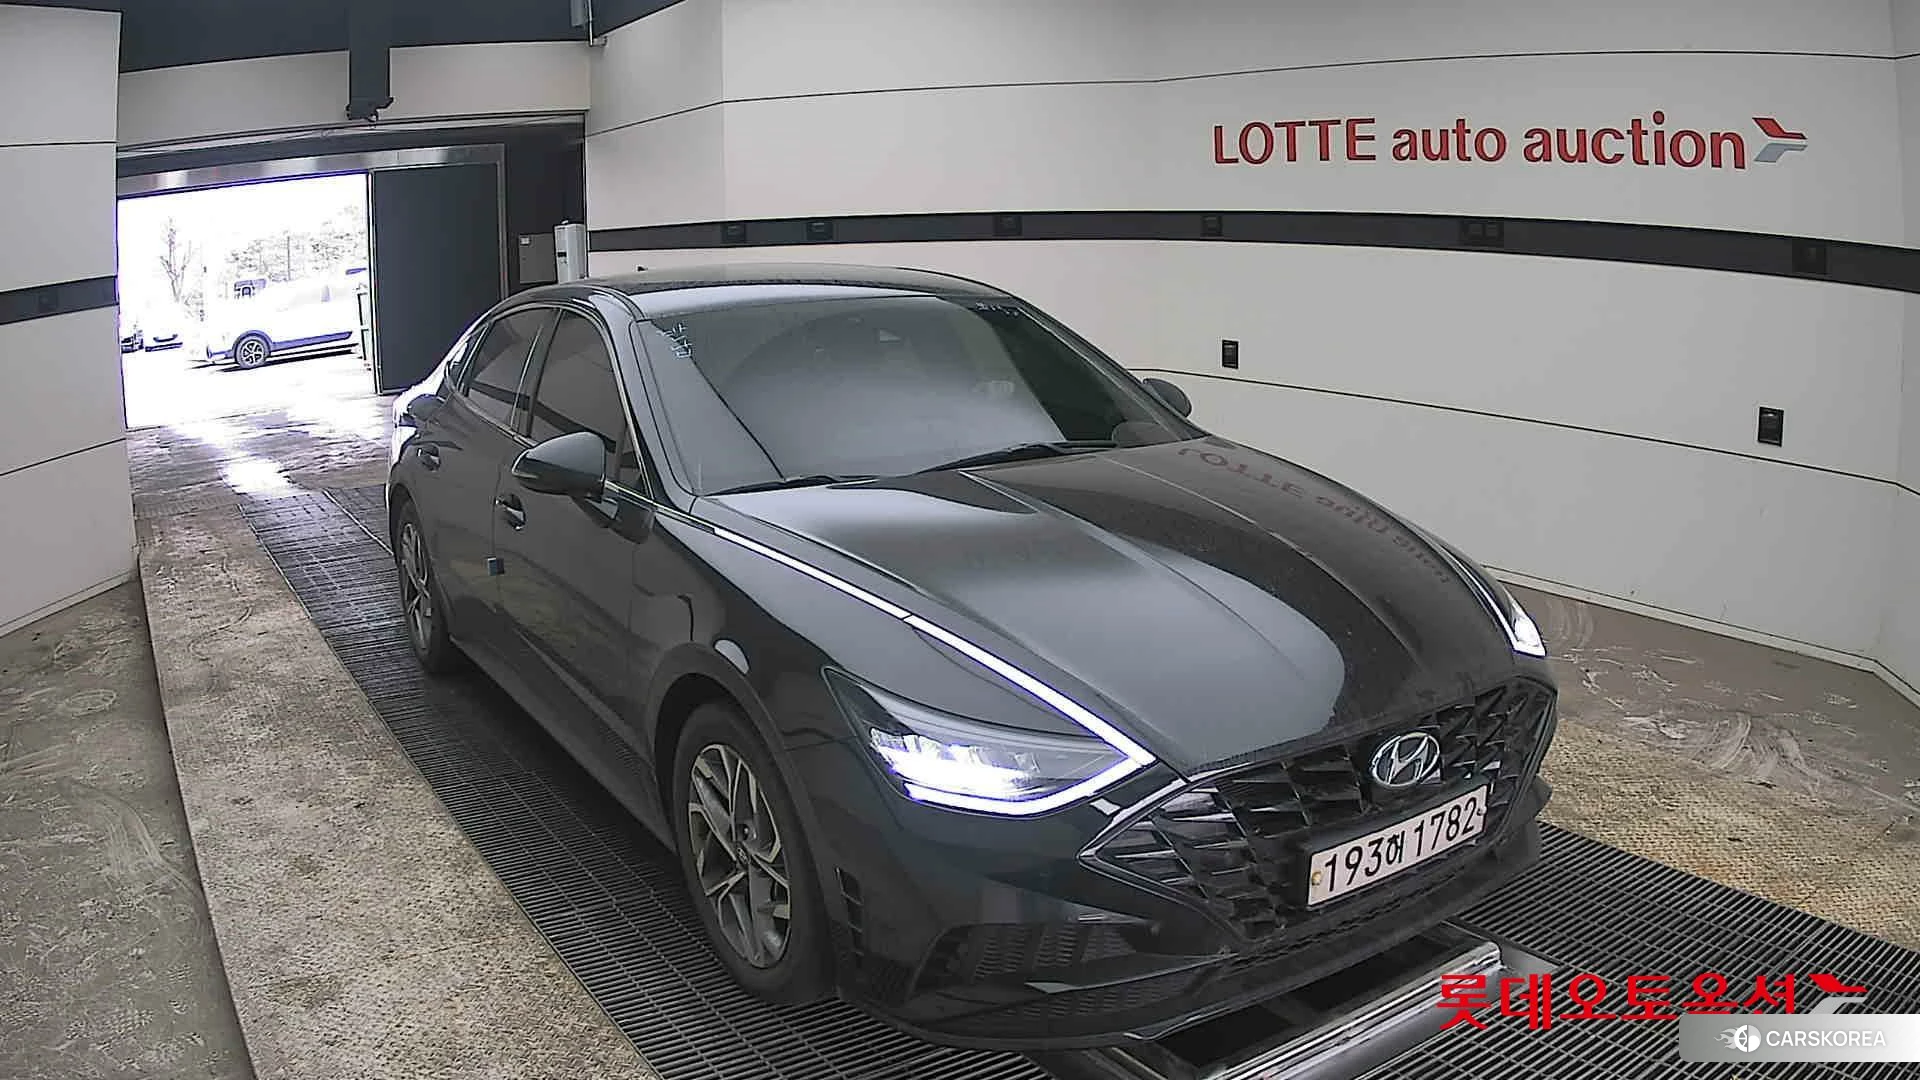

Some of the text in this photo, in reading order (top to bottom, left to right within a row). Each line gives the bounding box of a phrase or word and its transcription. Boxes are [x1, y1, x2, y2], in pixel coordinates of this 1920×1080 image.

[1213, 110, 1746, 170] LOTTE auto auction
[1325, 796, 1478, 893] 193허 1782
